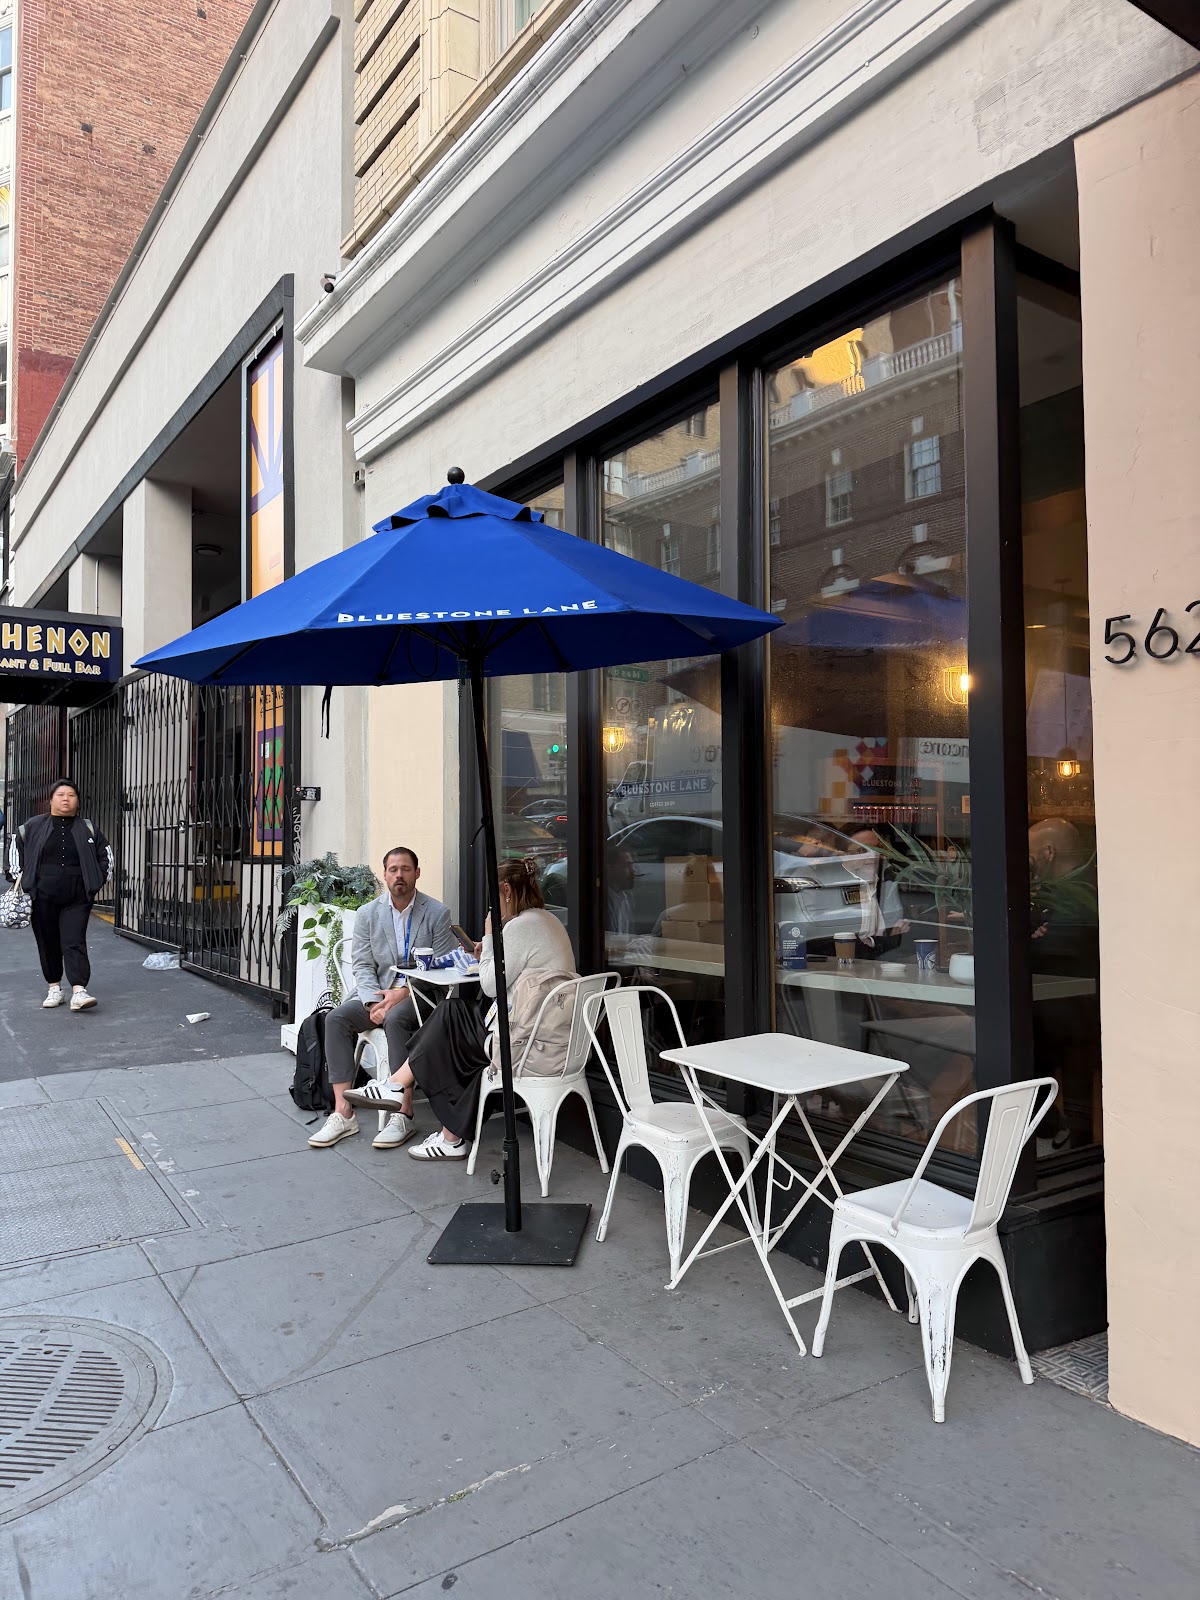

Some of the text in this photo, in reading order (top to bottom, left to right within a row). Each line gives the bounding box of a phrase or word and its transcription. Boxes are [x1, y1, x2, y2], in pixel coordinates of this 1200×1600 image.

[337, 600, 599, 623] BLUESTONE LANE
[29, 658, 39, 671] &
[43, 658, 71, 673] FULL
[75, 662, 101, 675] BAR
[621, 778, 707, 796] BLUESTONE LANE
[862, 780, 902, 788] BLUESTONE
